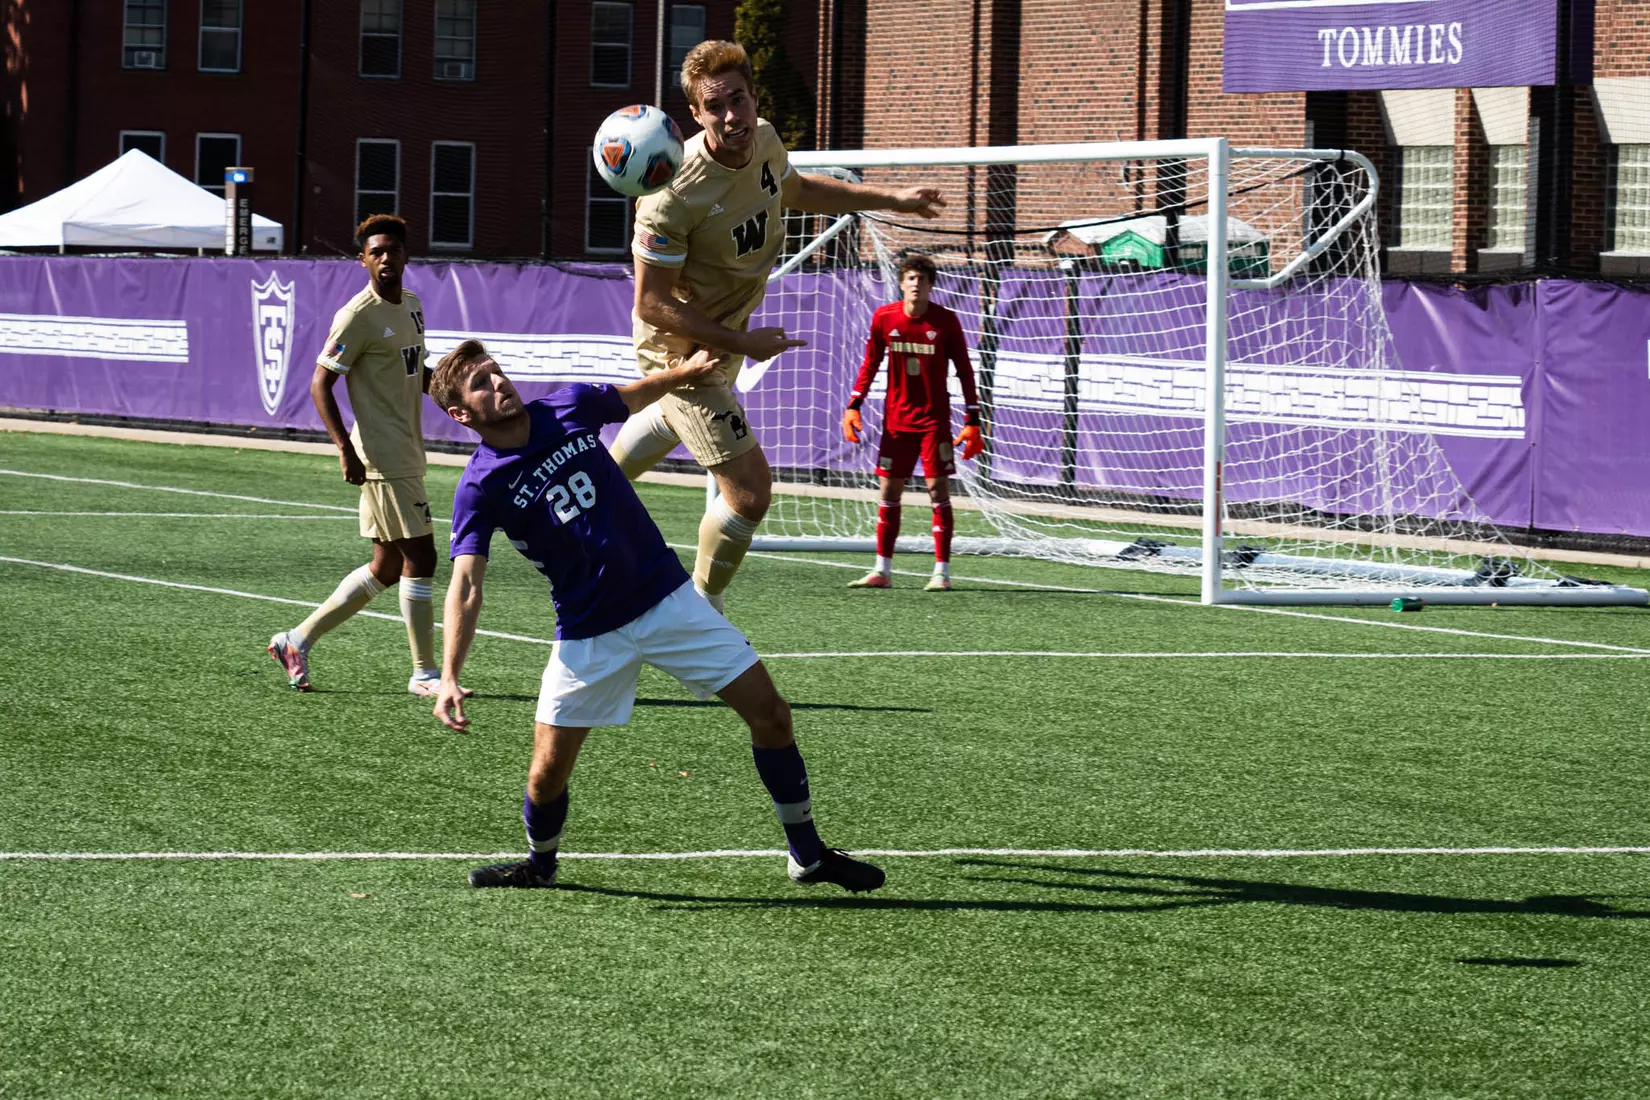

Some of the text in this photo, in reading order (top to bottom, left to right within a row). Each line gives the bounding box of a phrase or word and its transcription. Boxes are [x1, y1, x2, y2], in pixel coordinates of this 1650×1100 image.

[1318, 22, 1463, 68] TOMMIES
[760, 159, 779, 197] 4
[731, 207, 769, 260] W
[400, 344, 422, 377] W
[513, 434, 597, 509] ST. THOMAS
[545, 470, 596, 525] 28
